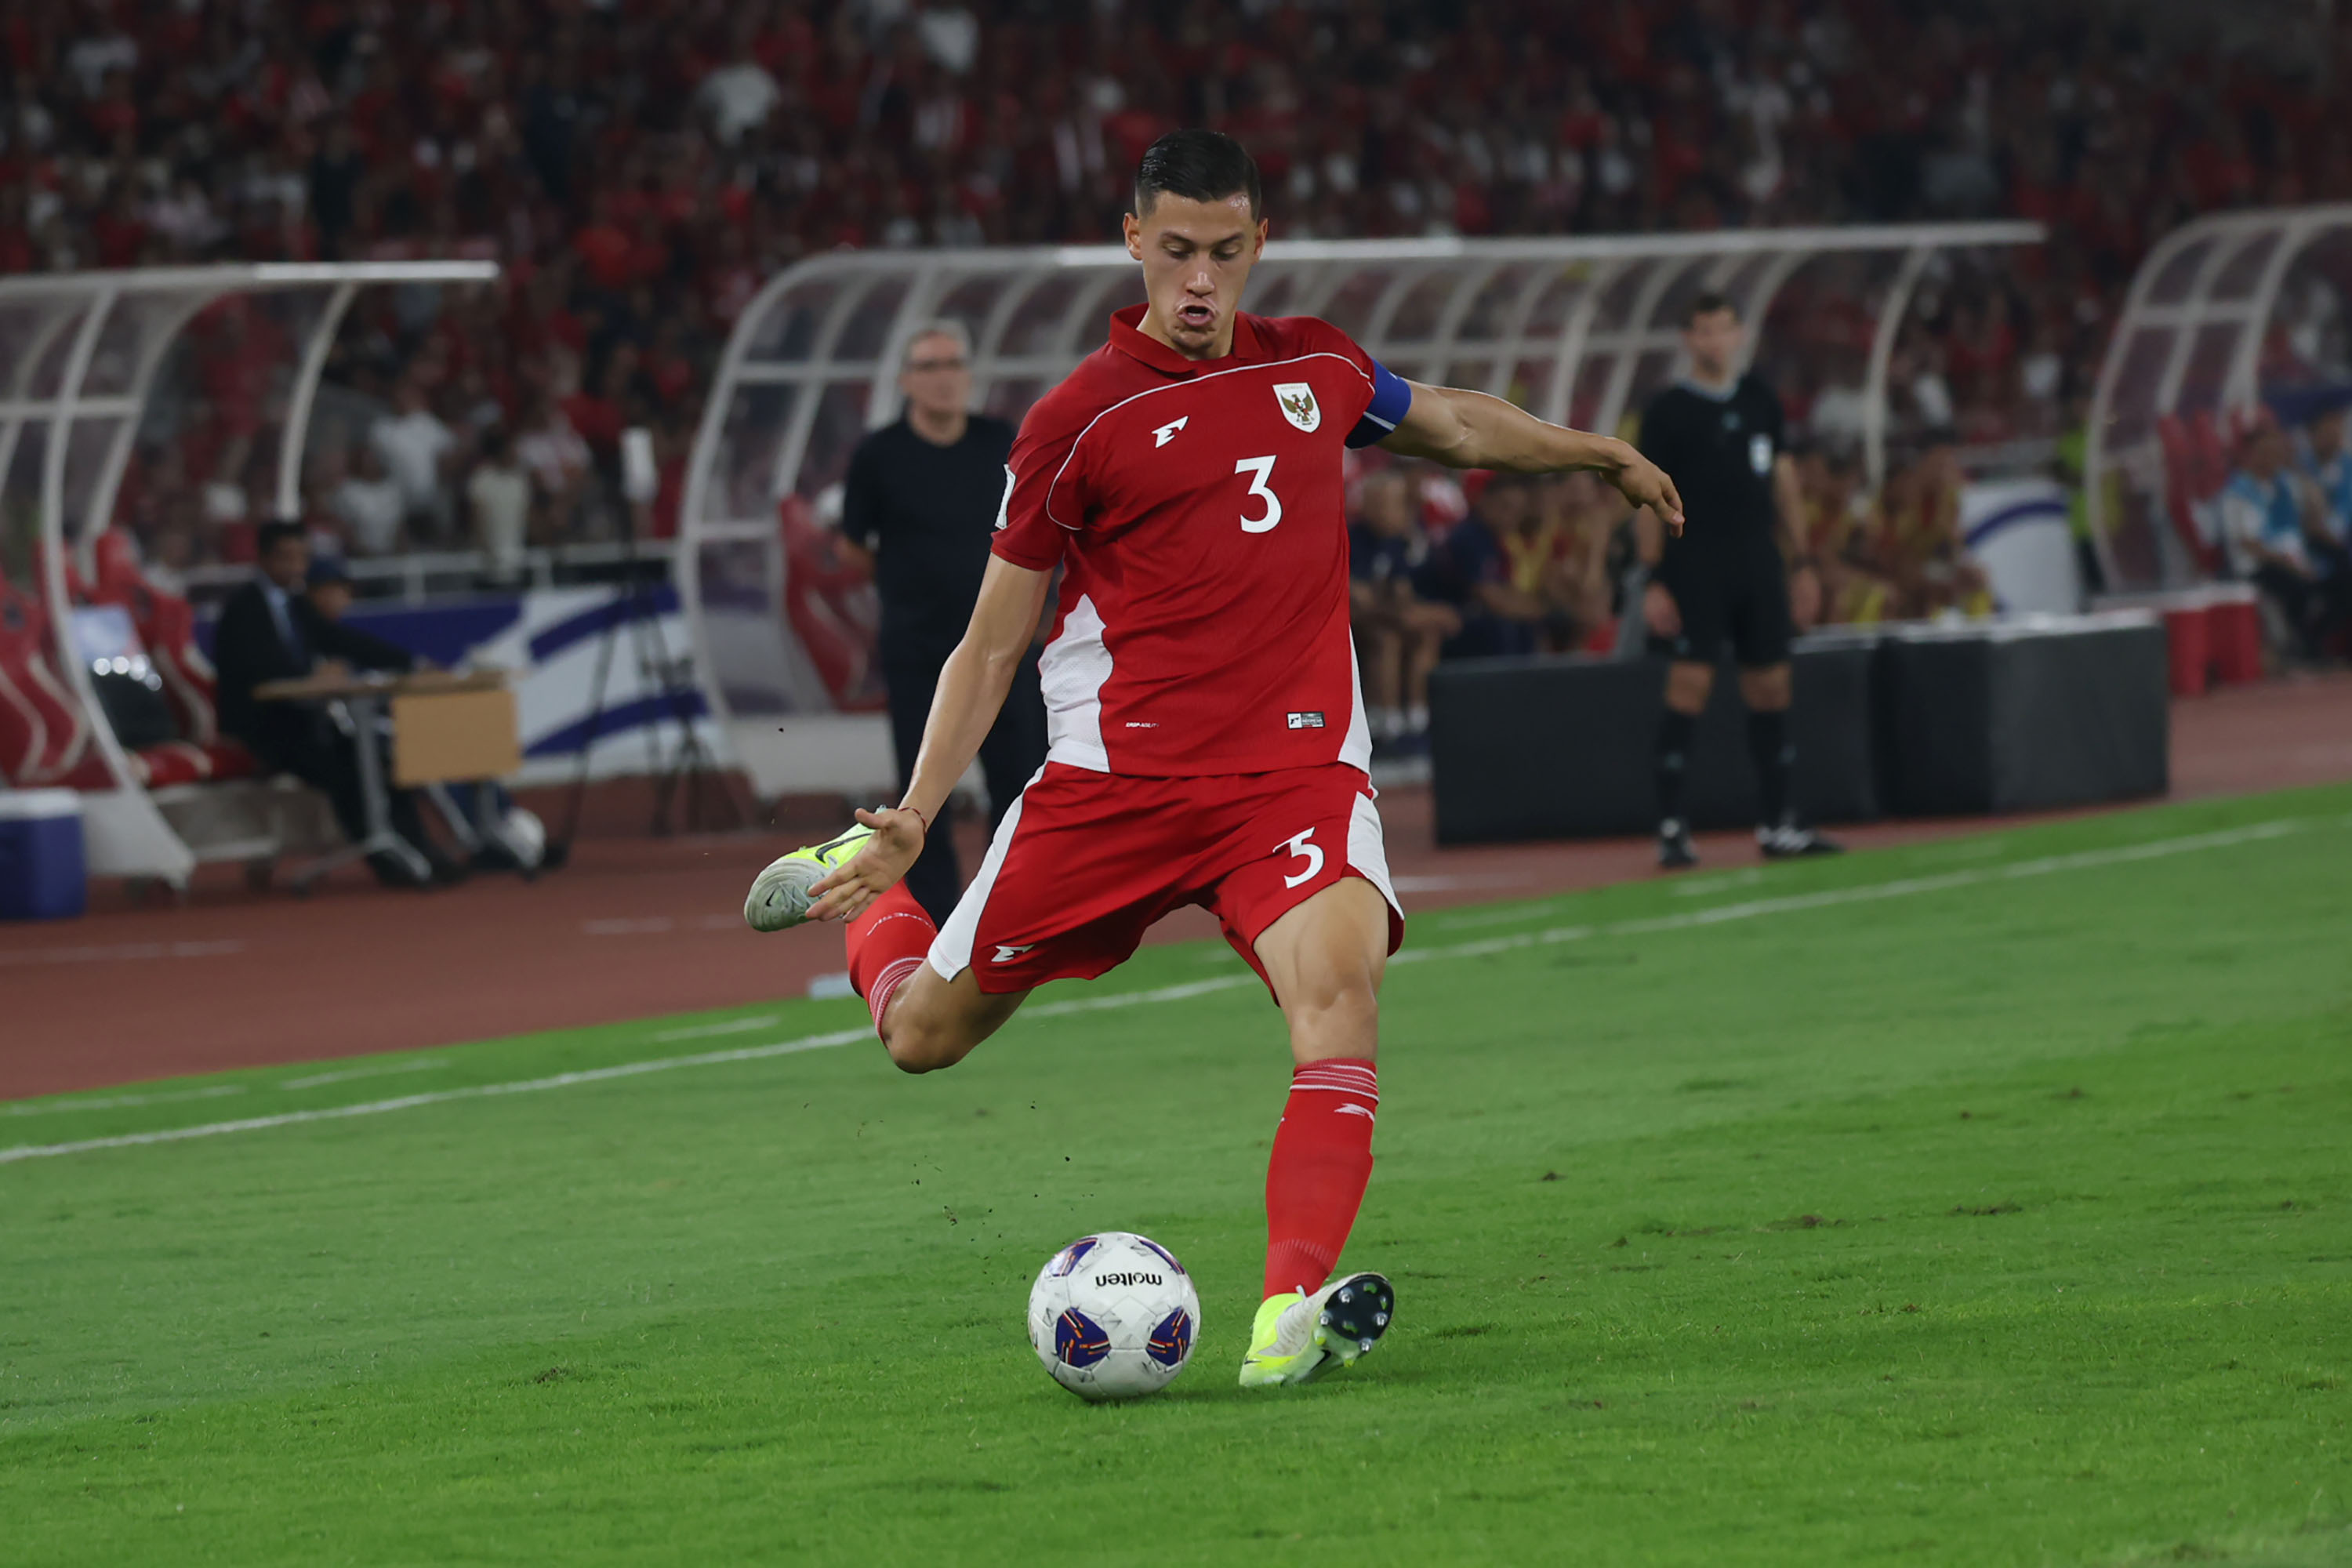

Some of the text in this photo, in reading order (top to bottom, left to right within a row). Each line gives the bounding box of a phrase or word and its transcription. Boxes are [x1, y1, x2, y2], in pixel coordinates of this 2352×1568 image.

[1234, 454, 1283, 533] 3
[1272, 826, 1325, 889] 3
[1095, 1272, 1163, 1287] molten
